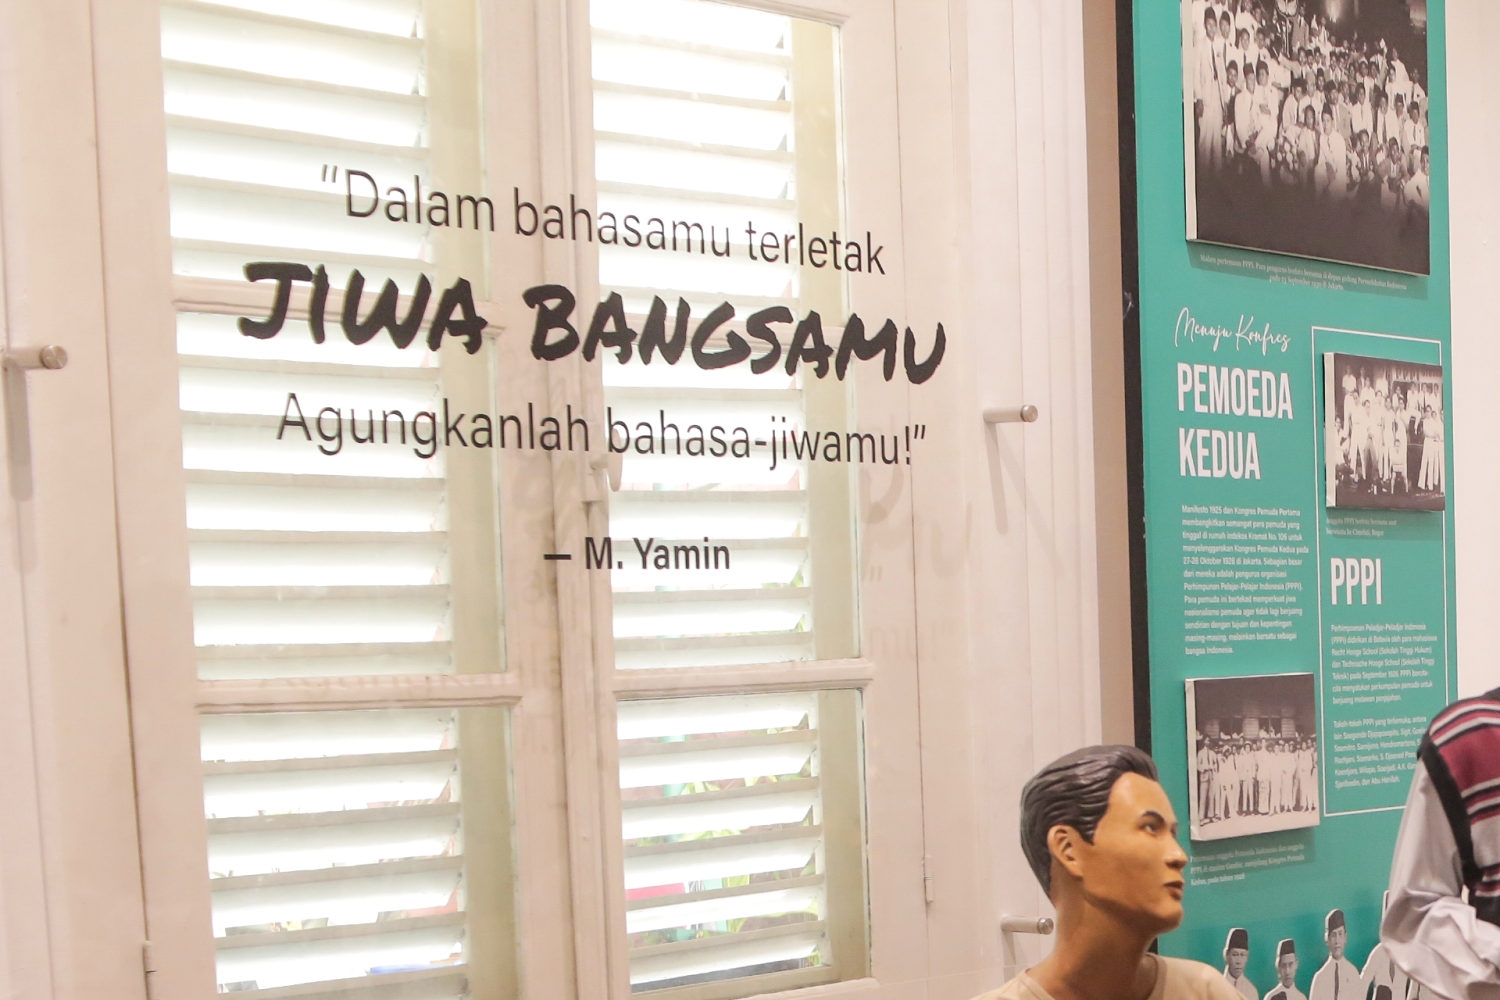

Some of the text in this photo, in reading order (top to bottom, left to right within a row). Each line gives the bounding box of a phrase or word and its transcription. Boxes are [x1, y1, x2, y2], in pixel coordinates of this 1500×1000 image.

[514, 187, 731, 258] bahasamu
[745, 220, 886, 275] terletak
[237, 261, 947, 385] JIWA BANGSAMU
[1177, 362, 1294, 420] PEMOEDA
[276, 391, 591, 459] Agungkanlah
[1178, 427, 1262, 480] KEDUA
[584, 536, 624, 570] M.
[633, 536, 731, 570] Yamin
[1330, 558, 1382, 605] PPPI
